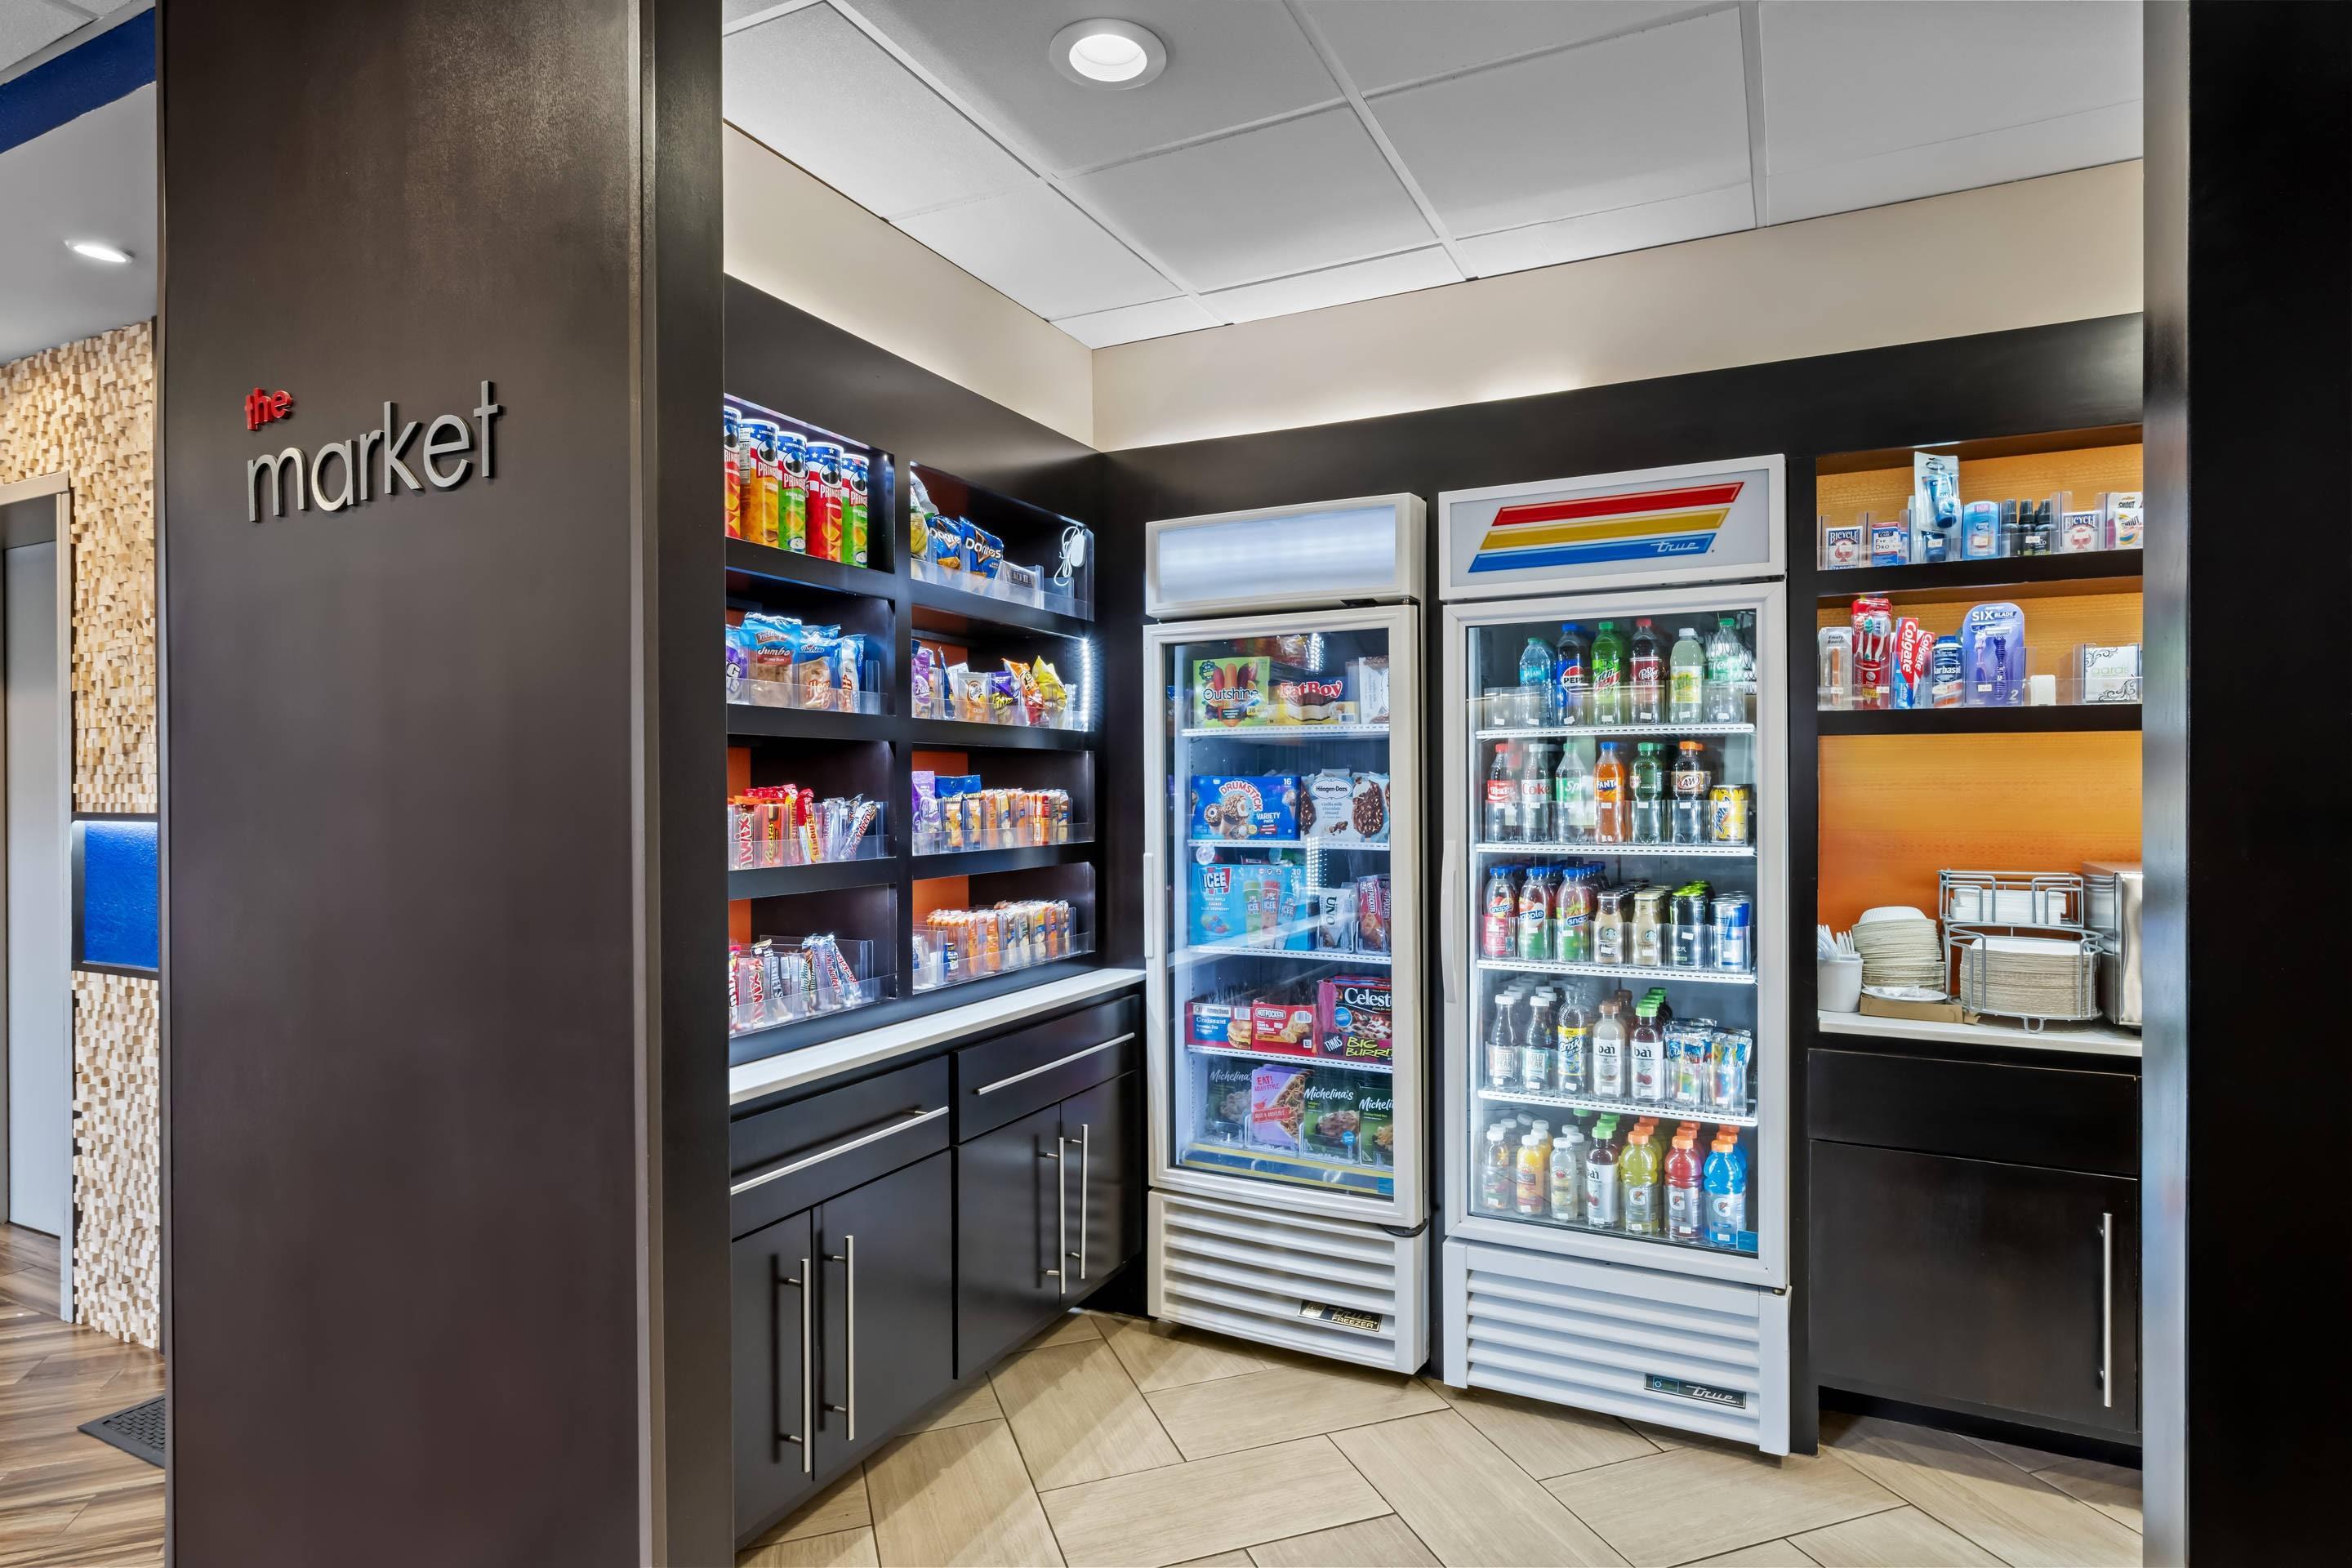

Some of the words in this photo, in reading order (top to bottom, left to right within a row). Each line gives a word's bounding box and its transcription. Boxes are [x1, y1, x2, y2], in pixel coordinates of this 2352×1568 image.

[244, 387, 293, 431] the
[247, 380, 504, 523] market
[2065, 514, 2096, 531] BICYCLE
[1829, 530, 1858, 546] BICYCLE
[965, 537, 1001, 559] Doritos
[1972, 611, 1994, 621] SIX
[757, 646, 791, 657] Jumbo
[1901, 621, 1917, 673] Colgate
[1914, 634, 1934, 670] Colgate
[1203, 687, 1259, 700] Outshine
[2009, 689, 2019, 701] 2
[1283, 777, 1292, 786] 16
[1522, 782, 1550, 795] Coke
[1218, 780, 1263, 812] DRUMSTICK
[1256, 812, 1281, 820] VARIETY
[1203, 871, 1228, 889] ICEE
[1247, 903, 1260, 911] ICEE
[1263, 901, 1276, 909] ICEE
[1281, 905, 1295, 916] ICEE
[1326, 897, 1338, 925] UNO
[1347, 1036, 1378, 1049] BIG
[1633, 1046, 1652, 1058] bai
[1257, 1076, 1273, 1085] EAT!
[1304, 1086, 1354, 1101] Michelina's
[1629, 1188, 1646, 1205] G
[1669, 1191, 1686, 1210] G
[1713, 1197, 1731, 1218] G
[1331, 1316, 1374, 1329] FREEZER
